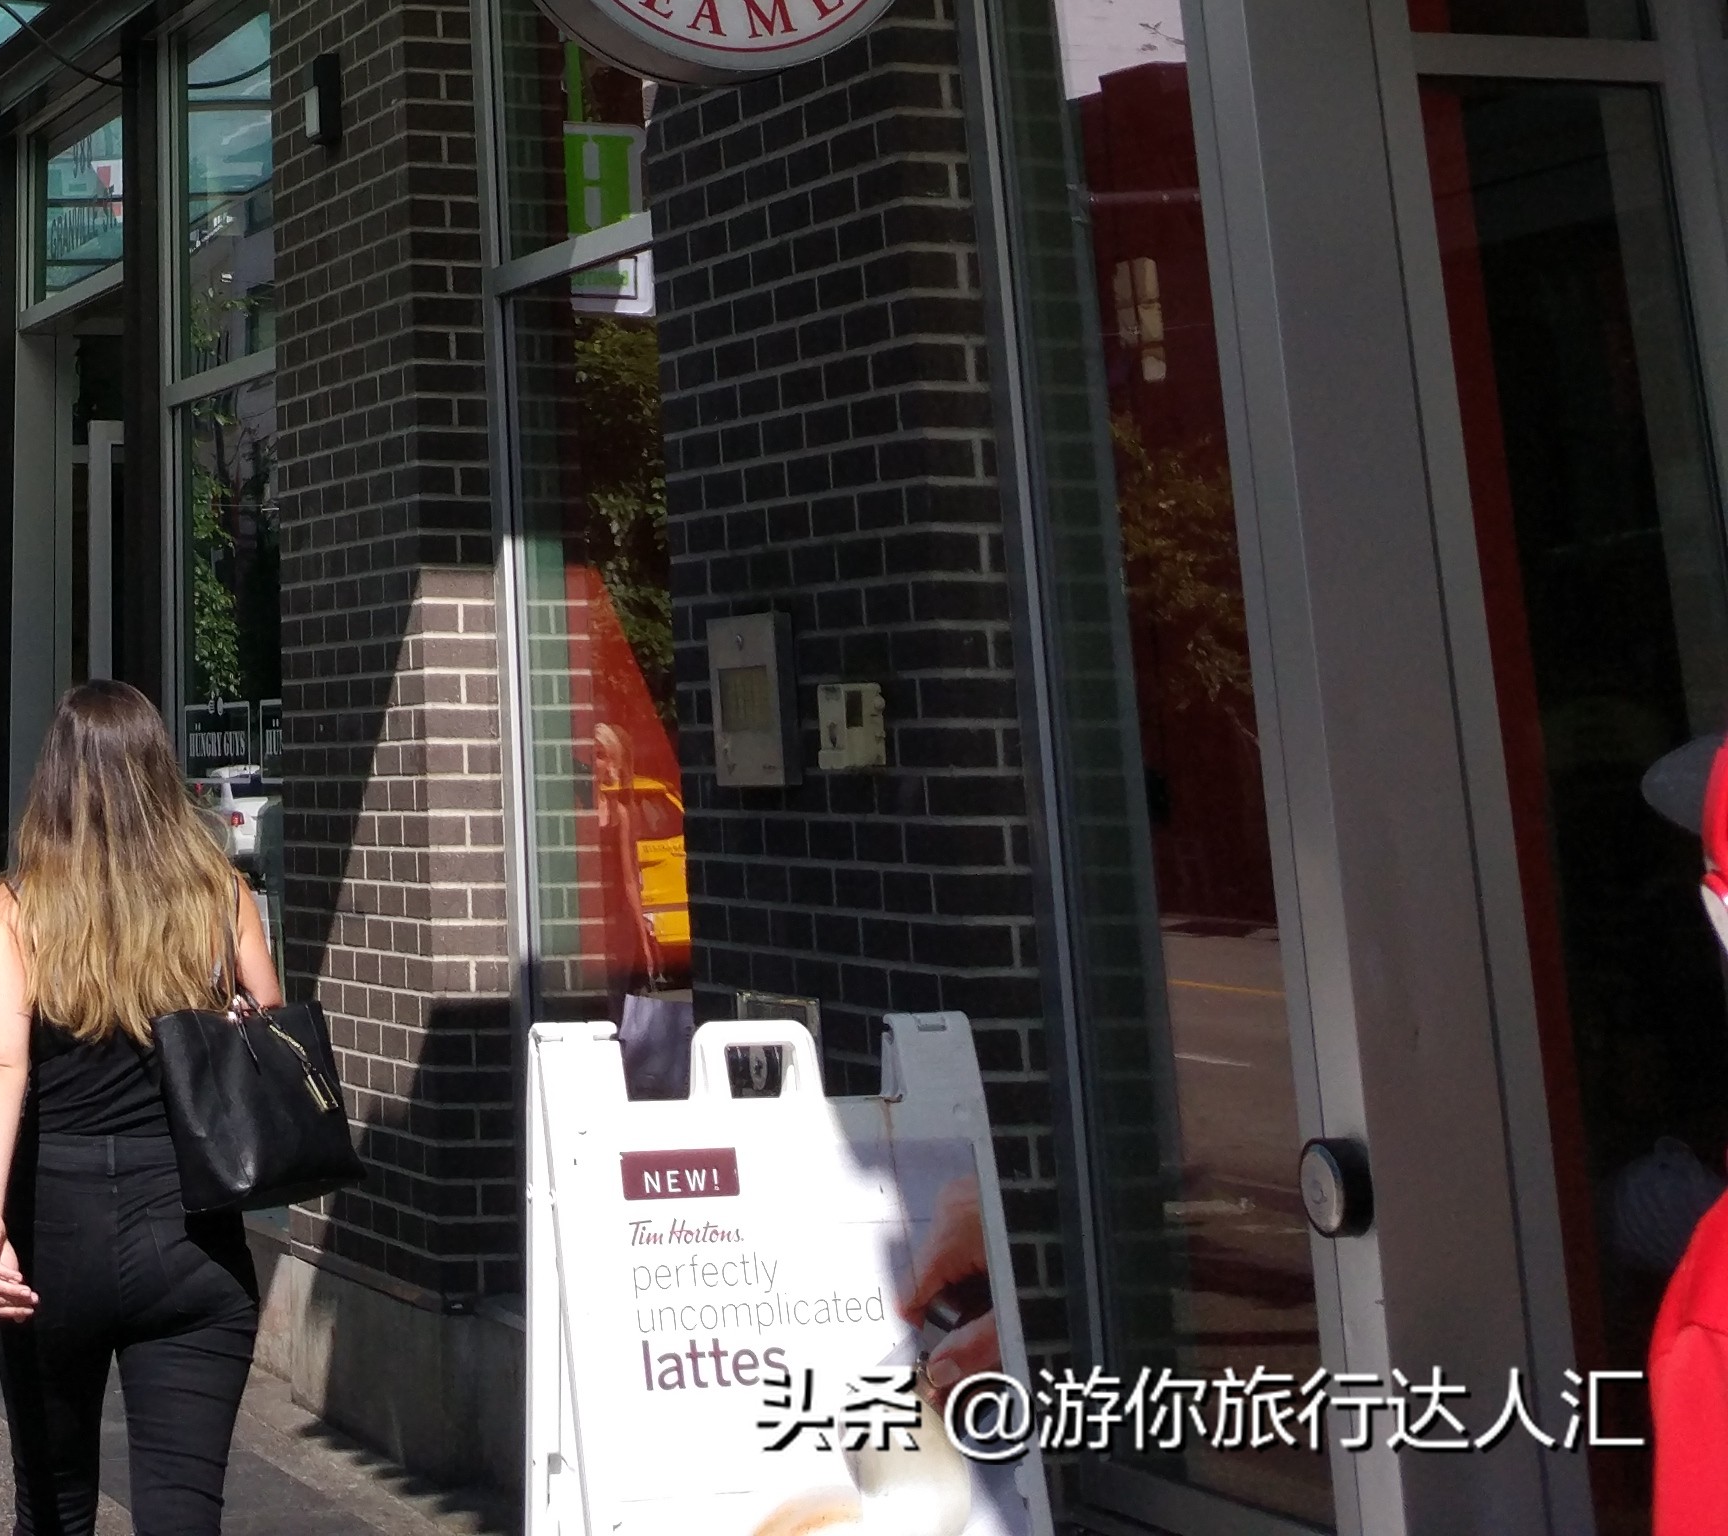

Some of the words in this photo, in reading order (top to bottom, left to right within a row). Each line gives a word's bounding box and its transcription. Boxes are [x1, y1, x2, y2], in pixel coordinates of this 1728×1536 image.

[223, 730, 246, 757] GUYS
[643, 1168, 720, 1194] NEW!
[628, 1219, 664, 1246] Tim
[632, 1252, 778, 1299] perfectly
[636, 1288, 886, 1336] uncomplicated
[641, 1337, 789, 1392] lattes
